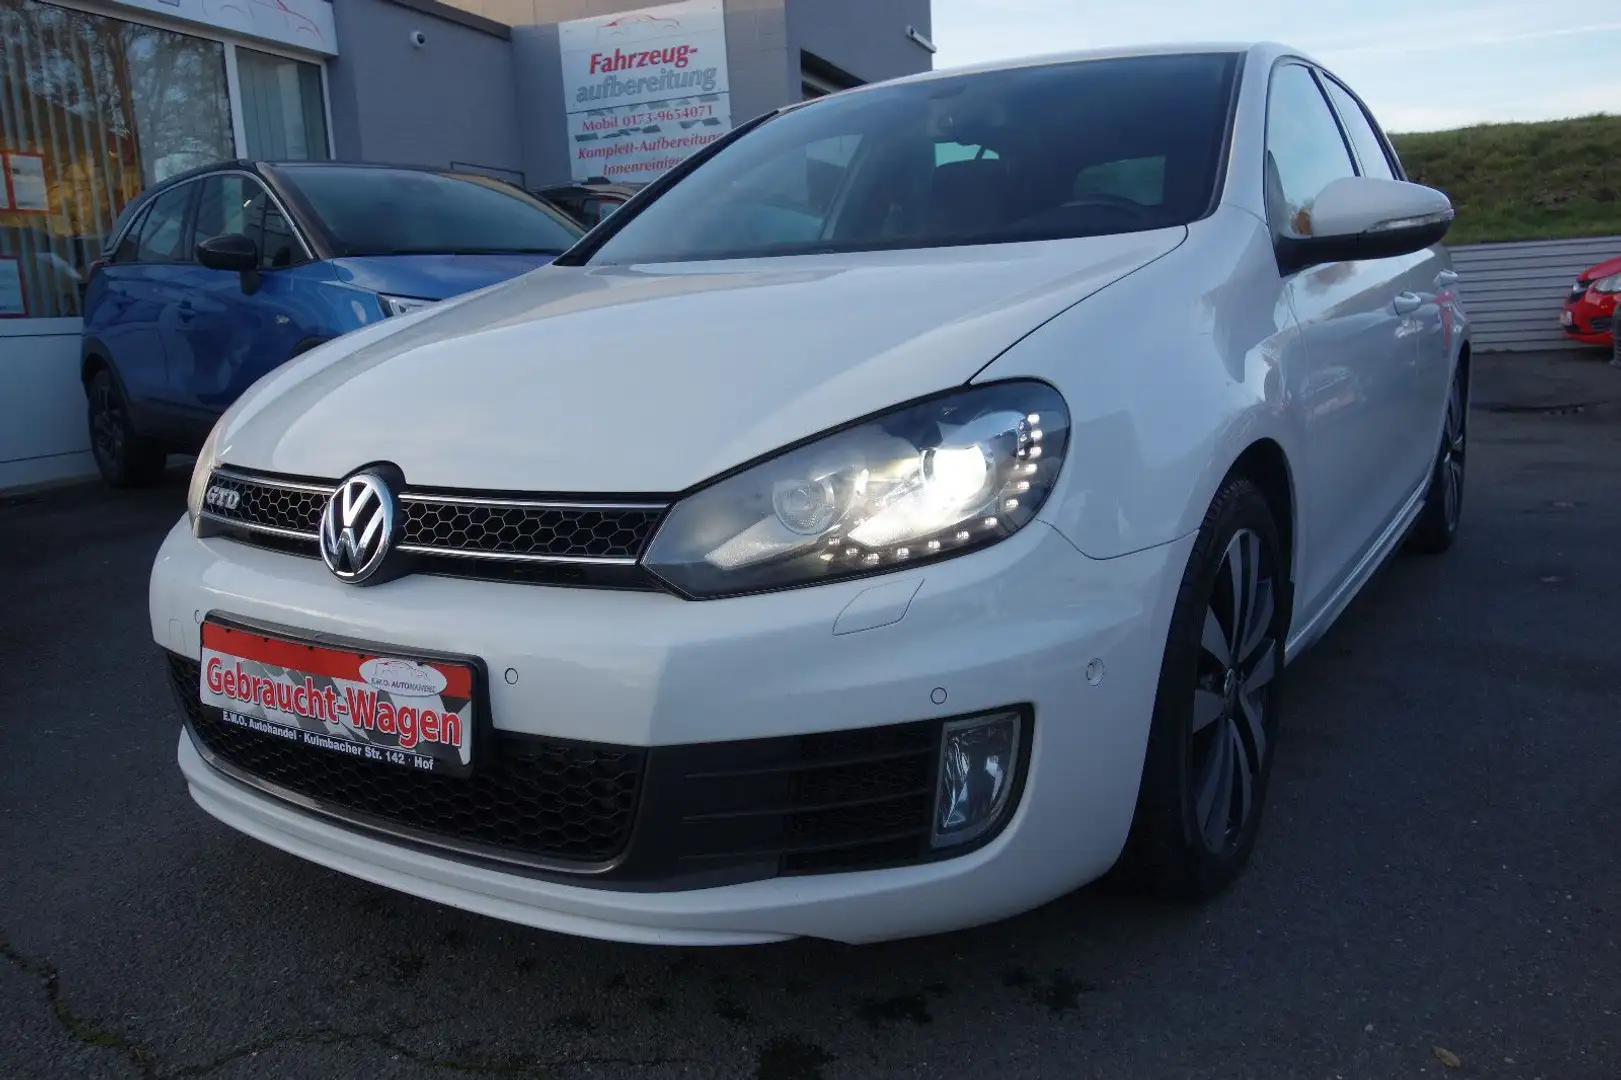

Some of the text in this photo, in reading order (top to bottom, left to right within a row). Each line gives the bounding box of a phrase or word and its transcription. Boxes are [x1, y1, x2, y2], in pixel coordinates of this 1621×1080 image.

[589, 44, 698, 75] Fahrzeug-
[576, 66, 718, 103] aufbereitung
[582, 117, 618, 132] Mobil
[205, 656, 463, 749] Gebraucht-Wagen
[222, 710, 434, 771] E.W.O. Autohandel Kulmbacher Str. 142 Hof
